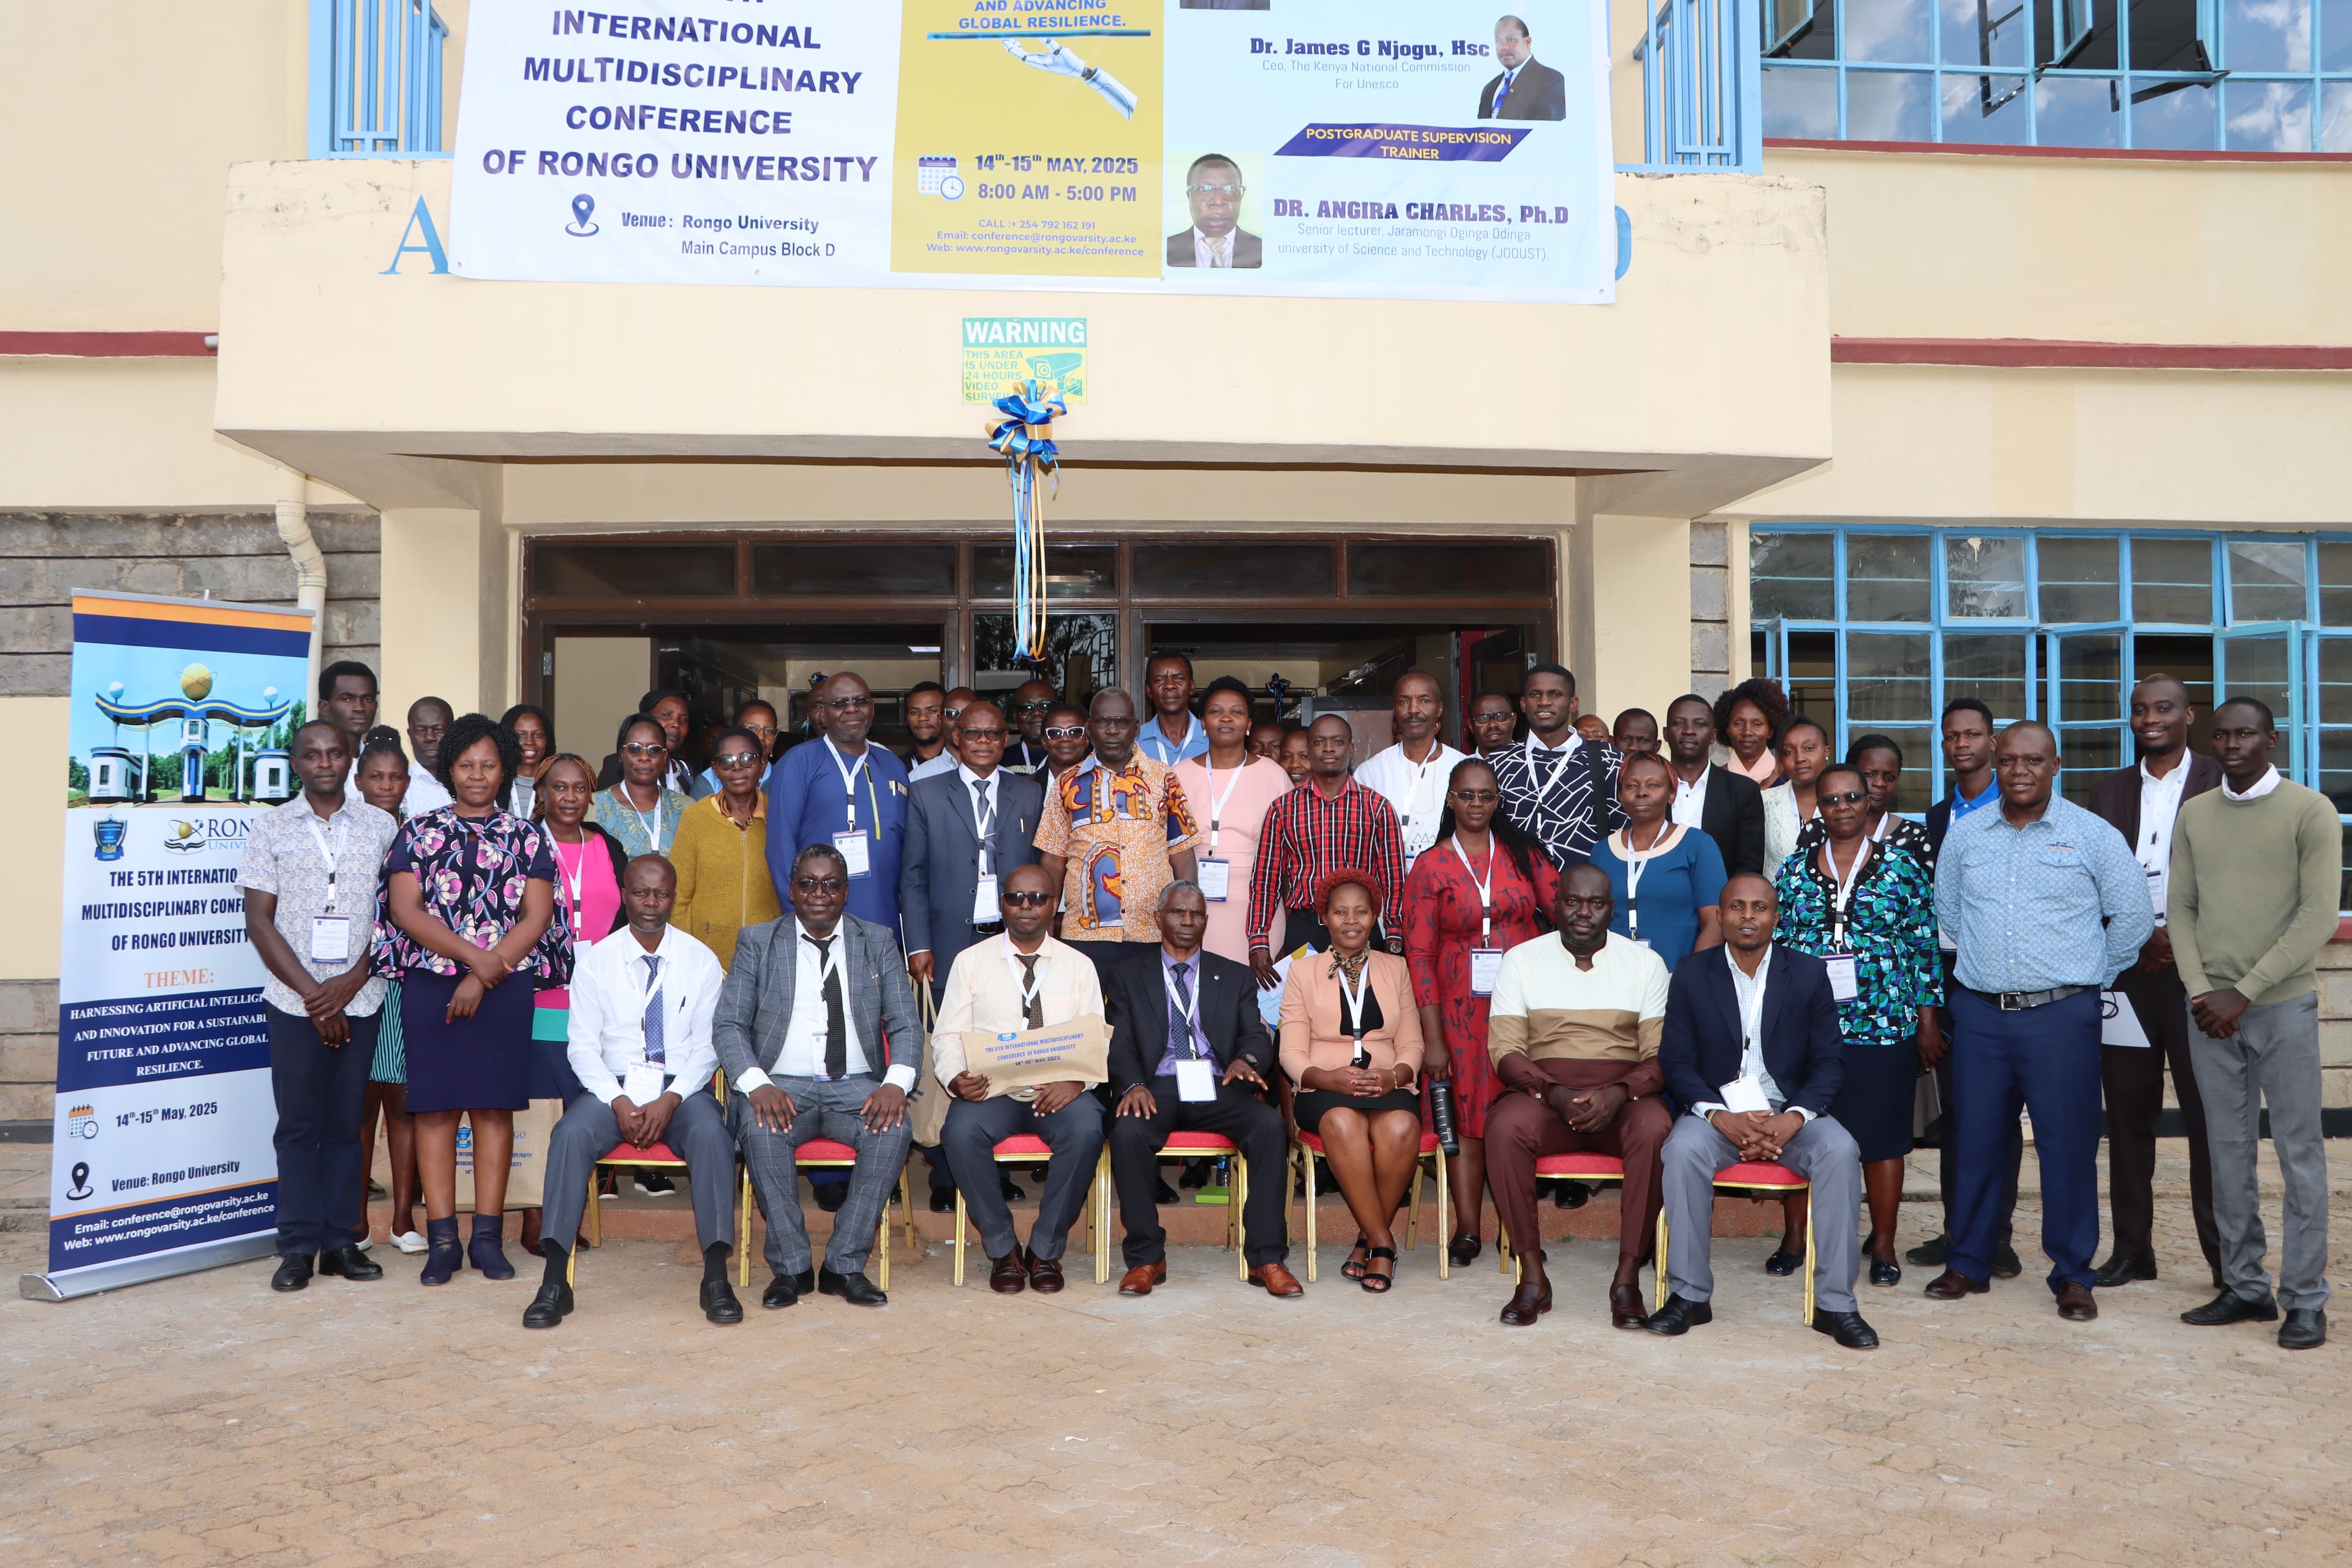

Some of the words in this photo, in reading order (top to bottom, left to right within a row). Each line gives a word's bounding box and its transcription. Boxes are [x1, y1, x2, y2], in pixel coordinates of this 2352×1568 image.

[974, 0, 1008, 11] AND
[1012, 0, 1107, 11] ADVANCING
[552, 10, 821, 49] INTERNATIONAL
[959, 17, 1022, 29] GLOBAL
[1027, 15, 1126, 28] RESILIENCE.
[1250, 37, 1278, 55] Dr.
[1285, 39, 1350, 56] James
[1357, 40, 1370, 56] G
[1378, 39, 1444, 61] Njogu,
[1452, 40, 1490, 58] Hsc
[523, 56, 862, 94] MULTIDISCIPLINARY
[1262, 60, 1286, 73] Ceo,
[1291, 61, 1310, 72] The
[1314, 61, 1348, 75] Kenya
[1351, 61, 1398, 72] National
[1401, 62, 1471, 73] Commission
[1335, 78, 1354, 89] For
[1357, 78, 1400, 89] Unesco
[565, 105, 792, 135] CONFERENCE
[1306, 128, 1419, 143] POSTGRADUATE
[1422, 130, 1512, 145] SUPERVISION
[1380, 146, 1439, 160] TRAINER
[483, 149, 526, 175] OF
[538, 150, 659, 178] RONGO
[671, 153, 878, 183] UNIVERSITY
[1047, 158, 1088, 174] MAY,
[1091, 157, 1138, 174] 2025
[978, 183, 1016, 199] 8:00
[1022, 184, 1049, 200] AM
[1066, 185, 1104, 201] 5:00
[1110, 186, 1136, 202] PM
[1273, 198, 1309, 218] DR.
[1317, 200, 1399, 220] ANGIRA
[1406, 203, 1512, 225] CHARLES,
[1520, 205, 1569, 224] Ph.D
[682, 214, 732, 232] Rongo
[737, 216, 819, 234] University
[978, 219, 1006, 228] CALL
[1020, 220, 1038, 228] 254
[1041, 221, 1060, 229] 792
[1062, 221, 1079, 230] 162
[1082, 221, 1096, 230] 191
[1298, 223, 1333, 235] Senior
[1337, 224, 1384, 239] lecturer,
[1387, 225, 1447, 239] Jaramongi
[1450, 227, 1488, 240] Oginga
[1492, 227, 1531, 242] Odinga
[937, 230, 969, 240] Email:
[971, 232, 1137, 244] conference@rongovarsity.ac.ke
[681, 240, 714, 255] Main
[718, 241, 777, 259] Campus
[781, 242, 820, 257] Block
[825, 243, 835, 257] D
[926, 243, 953, 252] Web:
[956, 245, 1144, 256] www.rongovarsity.ac.ke/conference
[1278, 242, 1335, 257] university
[1338, 243, 1349, 255] of
[1352, 243, 1397, 256] Science
[1401, 244, 1422, 257] and
[1425, 245, 1488, 260] Technology
[965, 322, 1085, 344] WARNING
[209, 841, 245, 850] UNIV
[110, 871, 135, 887] THE
[137, 870, 163, 886] 5TH
[82, 899, 207, 920] MULTIDISCIPLINARY
[112, 935, 128, 951] OF
[132, 933, 176, 949] RONGO
[180, 929, 248, 946] UNIVERSITY
[144, 968, 214, 988] THEME:
[70, 1004, 144, 1020] HARNESSING
[146, 998, 208, 1012] ARTIFICIAL
[74, 1030, 97, 1041] AND
[100, 1023, 171, 1038] INNOVATION
[173, 1021, 195, 1032] FOR
[87, 1048, 134, 1061] FUTURE
[136, 1046, 159, 1056] AND
[161, 1038, 224, 1054] ADVANCING
[226, 1034, 269, 1046] GLOBAL
[1005, 1041, 1039, 1050] INTERNATIONAL
[1039, 1033, 1084, 1044] MULTIDISCIPLINARY
[1050, 1044, 1076, 1053] UNIVERSITY
[137, 1060, 203, 1076] RESILIENCE.
[161, 1108, 187, 1121] May,
[189, 1102, 217, 1117] 2025
[112, 1175, 149, 1192] Venue:
[152, 1170, 185, 1185] Rongo
[188, 1160, 240, 1179] University
[75, 1220, 110, 1235] Email:
[111, 1191, 268, 1229] conference@rongovarsity.ac.ke
[64, 1236, 93, 1251] Web:
[95, 1204, 275, 1245] www.rongovarsity.ac.ke/conference
